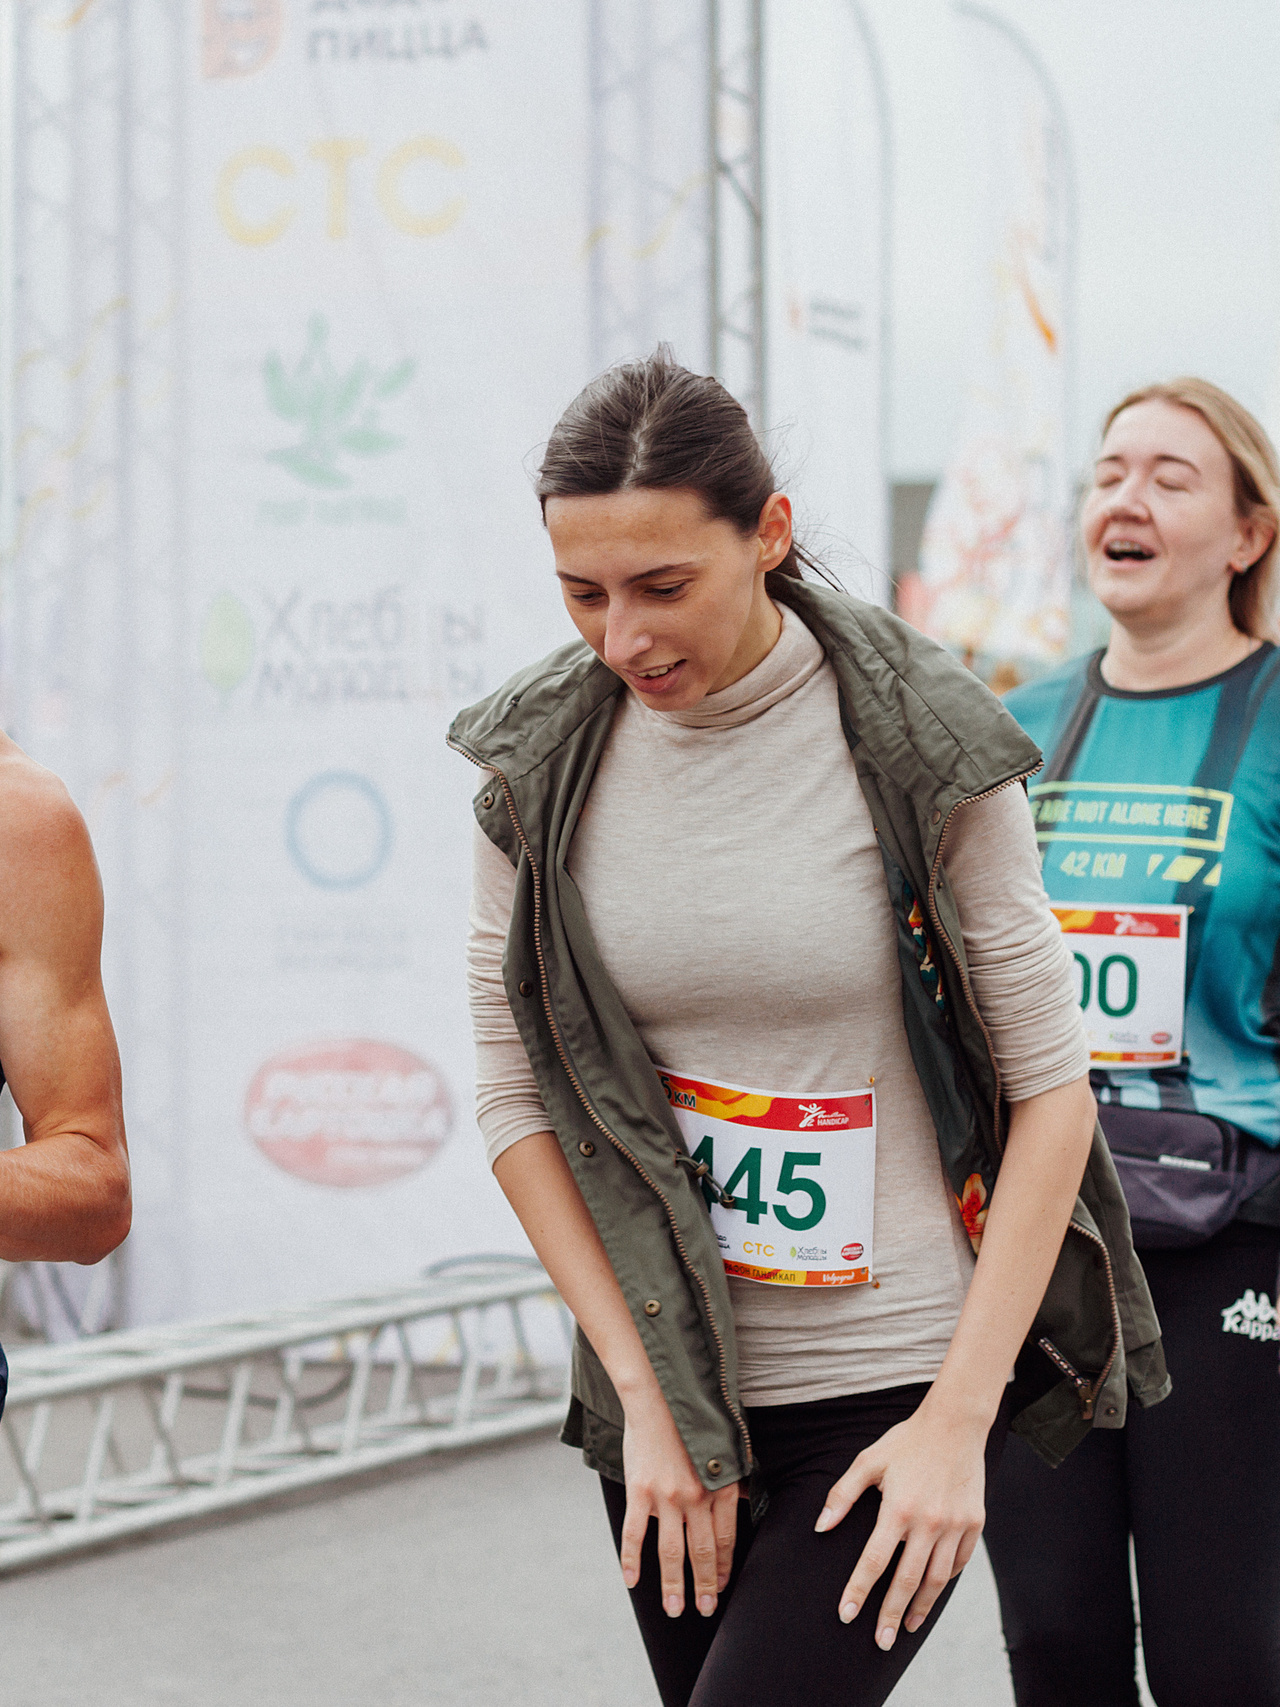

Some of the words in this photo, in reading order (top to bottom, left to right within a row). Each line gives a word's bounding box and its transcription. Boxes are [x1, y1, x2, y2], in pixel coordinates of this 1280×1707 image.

[308, 20, 489, 63] ПИЦЦА
[1073, 801, 1109, 823] NOT
[1108, 802, 1164, 826] ALONE
[1163, 804, 1211, 830] HERE
[1060, 851, 1090, 877] 42
[817, 1117, 849, 1126] HANDICAP
[752, 1269, 796, 1281] ГАНДИКАП
